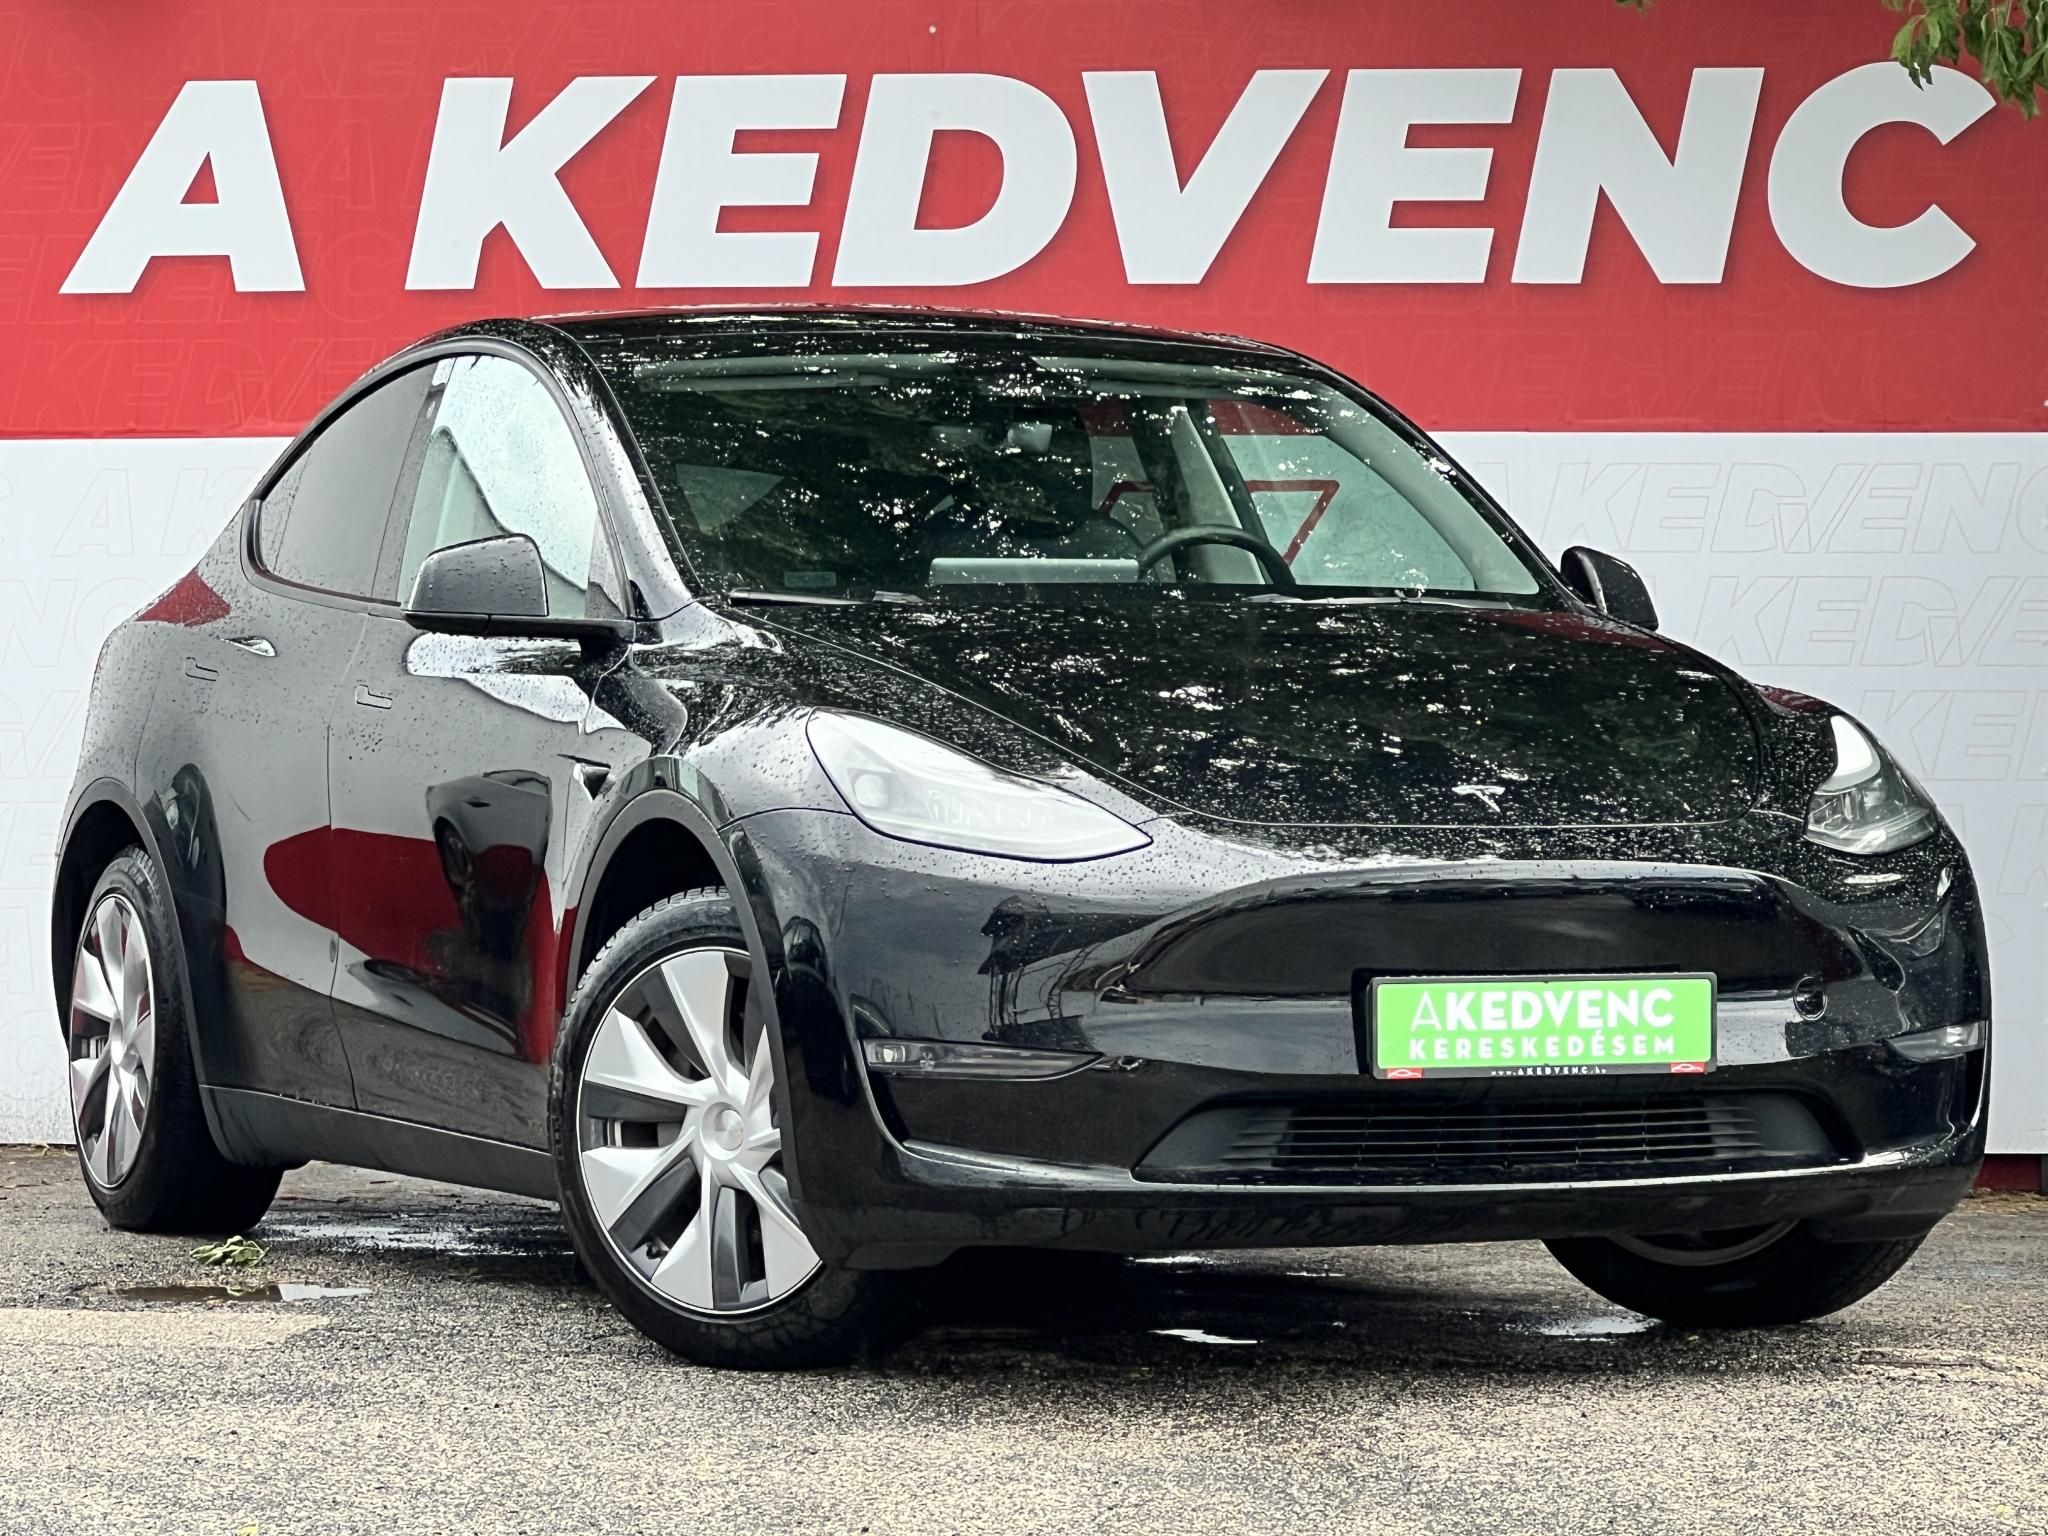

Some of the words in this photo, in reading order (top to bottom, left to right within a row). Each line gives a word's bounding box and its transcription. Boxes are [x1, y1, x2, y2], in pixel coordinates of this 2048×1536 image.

[60, 80, 305, 294] A
[405, 61, 1997, 289] KEDVENC
[1409, 1029, 1674, 1060] KERESKEDÉSEM
